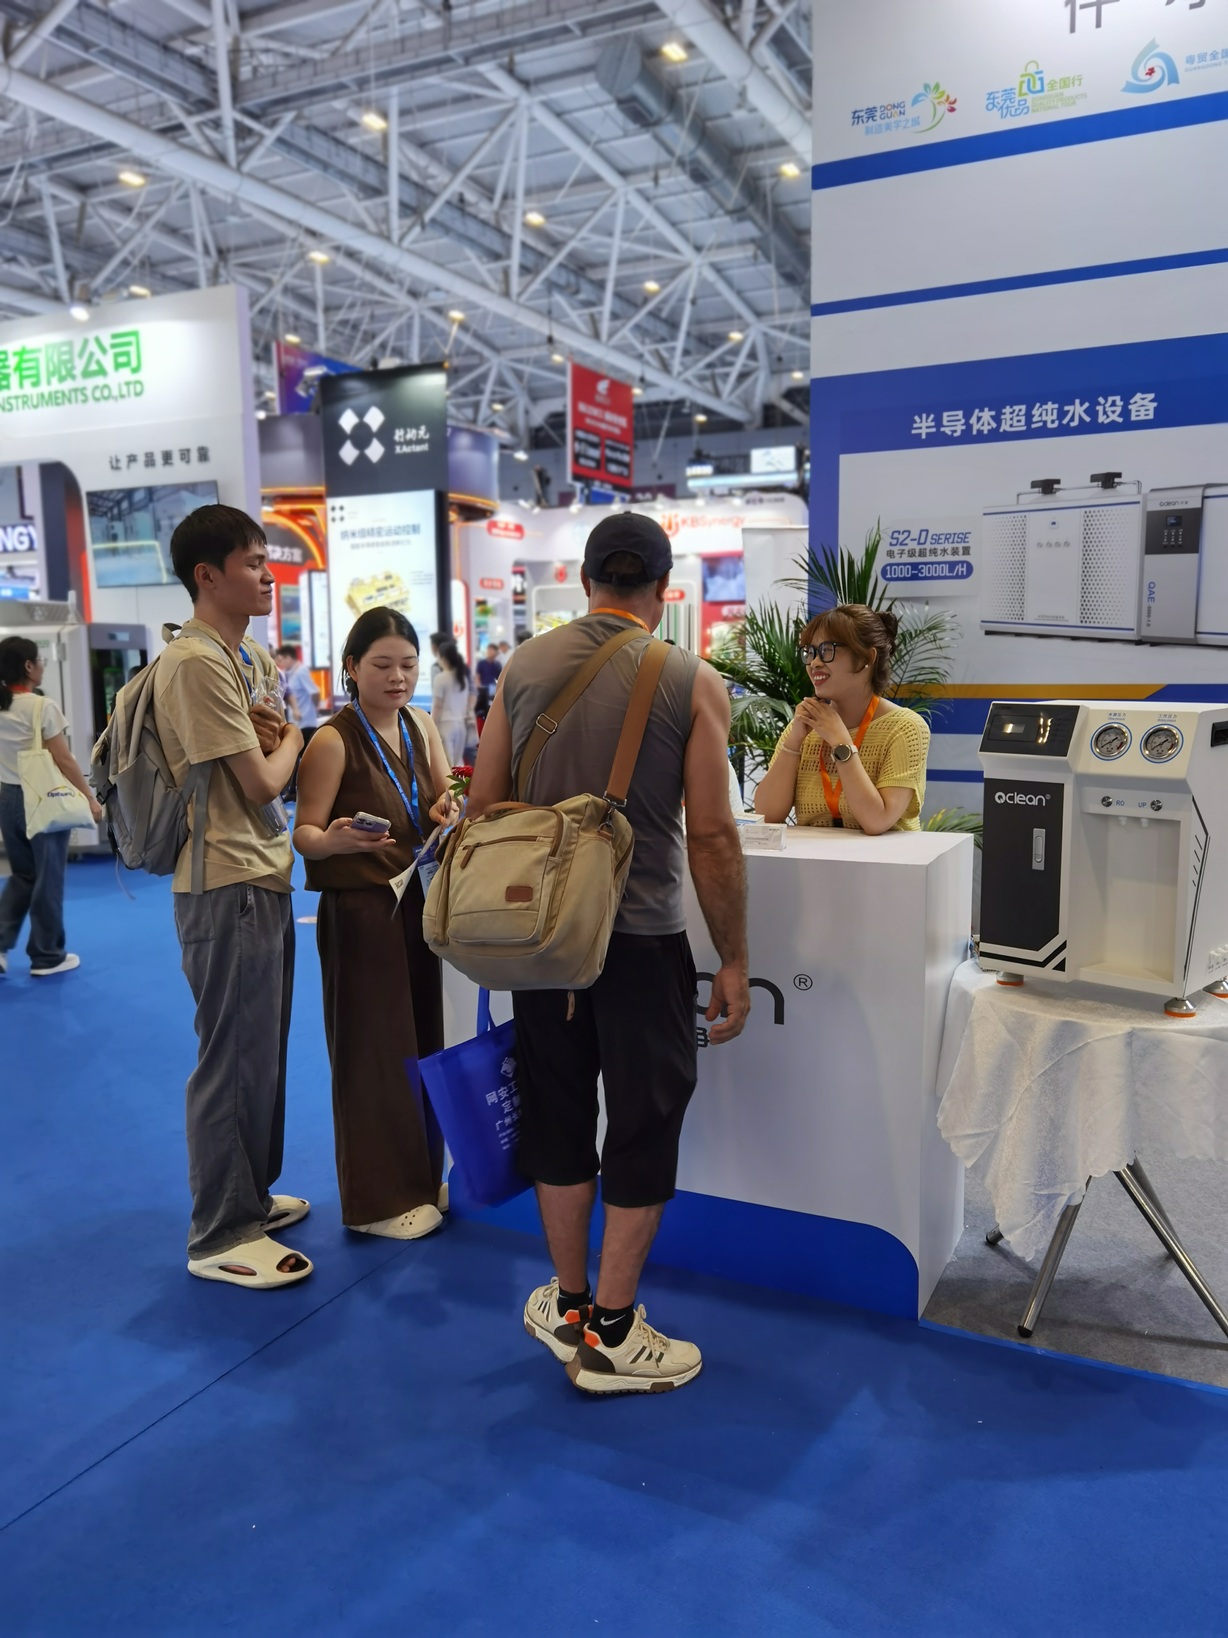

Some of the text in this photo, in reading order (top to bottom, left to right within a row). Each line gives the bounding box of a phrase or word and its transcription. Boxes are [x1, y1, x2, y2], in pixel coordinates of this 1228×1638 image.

[1047, 74, 1083, 92] 全国行
[879, 101, 906, 112] DONG
[879, 109, 906, 120] GUAN
[851, 106, 878, 126] 东莞
[911, 392, 1158, 440] 半导体超纯水设备
[109, 445, 211, 471] 让产品更可靠
[889, 529, 972, 547] S2-D SERISE
[886, 546, 971, 559] 电子级超纯水装置
[885, 563, 967, 578] 1000~3000L/H
[994, 791, 1046, 807] Qclean
